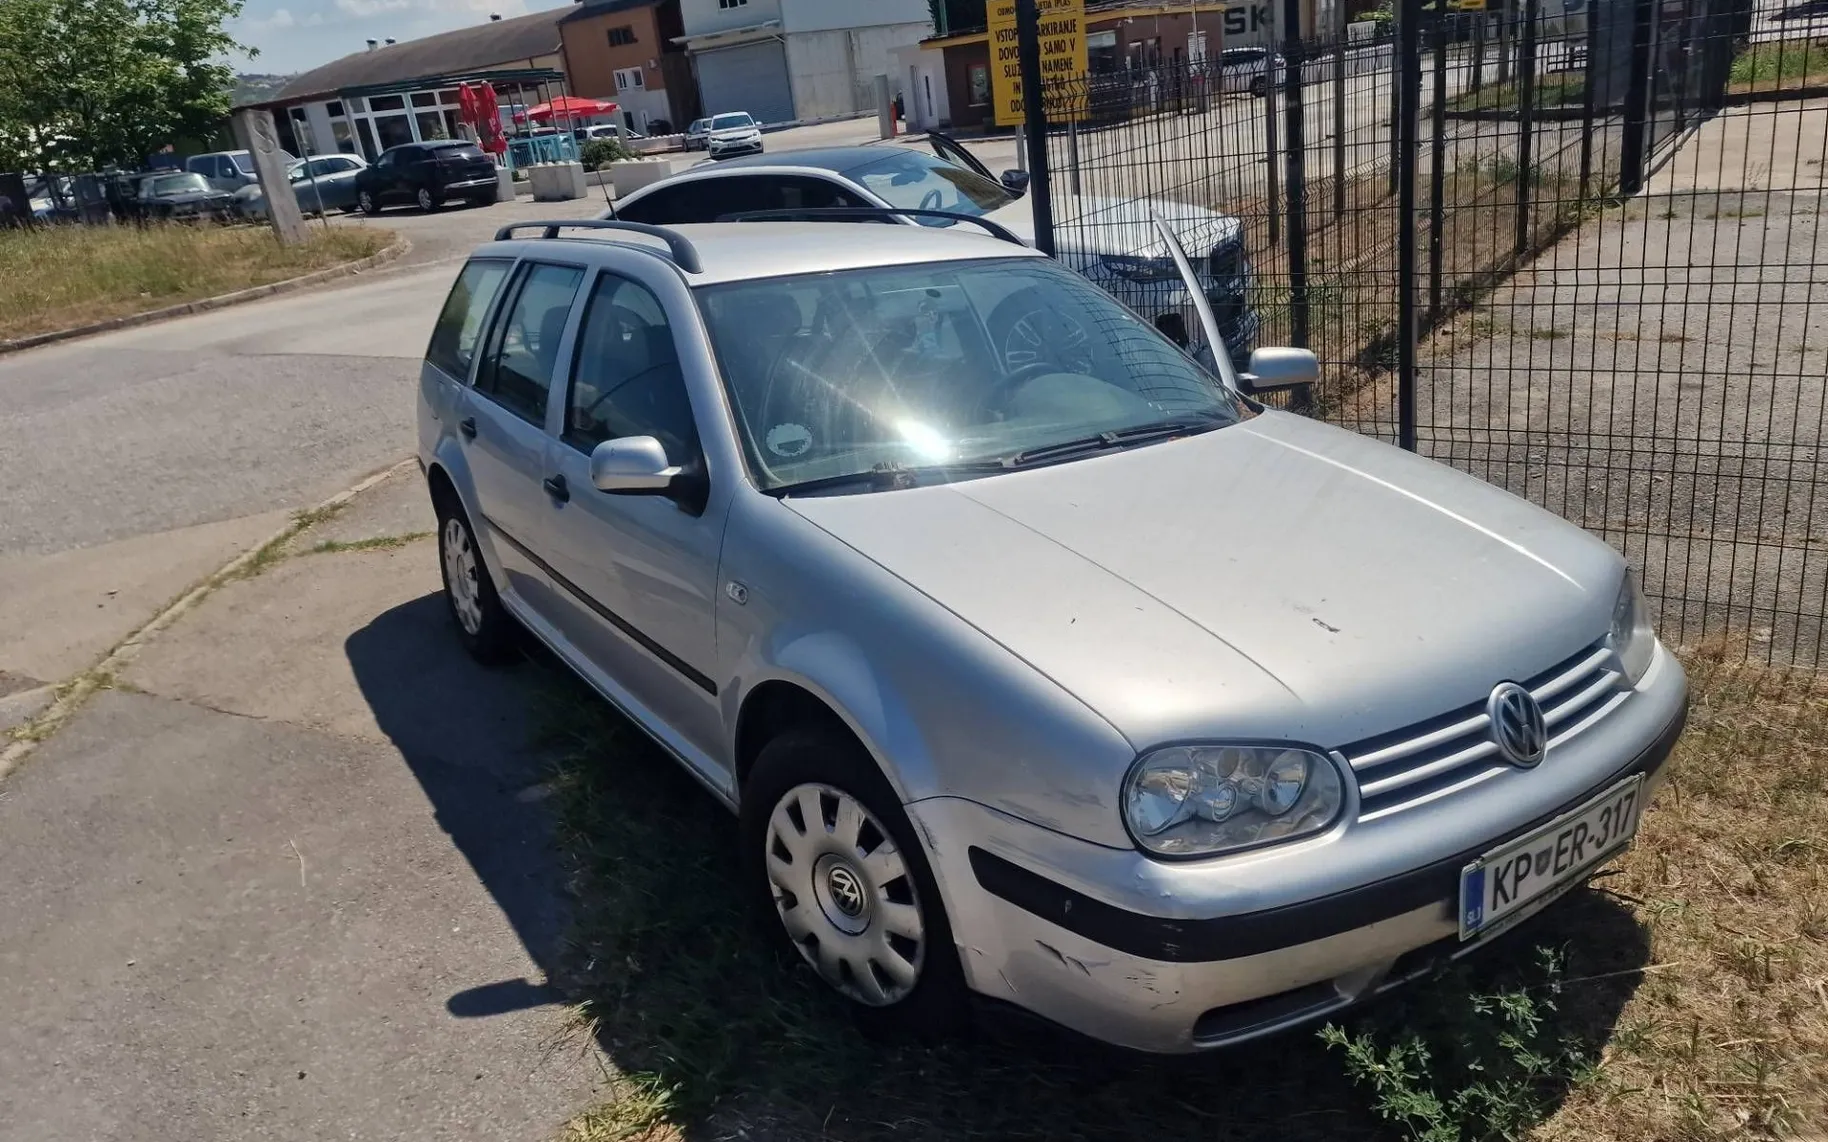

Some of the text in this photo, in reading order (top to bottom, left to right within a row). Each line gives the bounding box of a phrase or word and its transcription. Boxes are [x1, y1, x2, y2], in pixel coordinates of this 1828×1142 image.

[995, 19, 1077, 43] VSTOP ARKIRANJE
[999, 38, 1076, 61] DOVO SAMO V
[1042, 57, 1074, 74] NAMENE
[1013, 82, 1021, 94] IN
[1492, 852, 1532, 911] KP
[1552, 790, 1636, 876] ER-317
